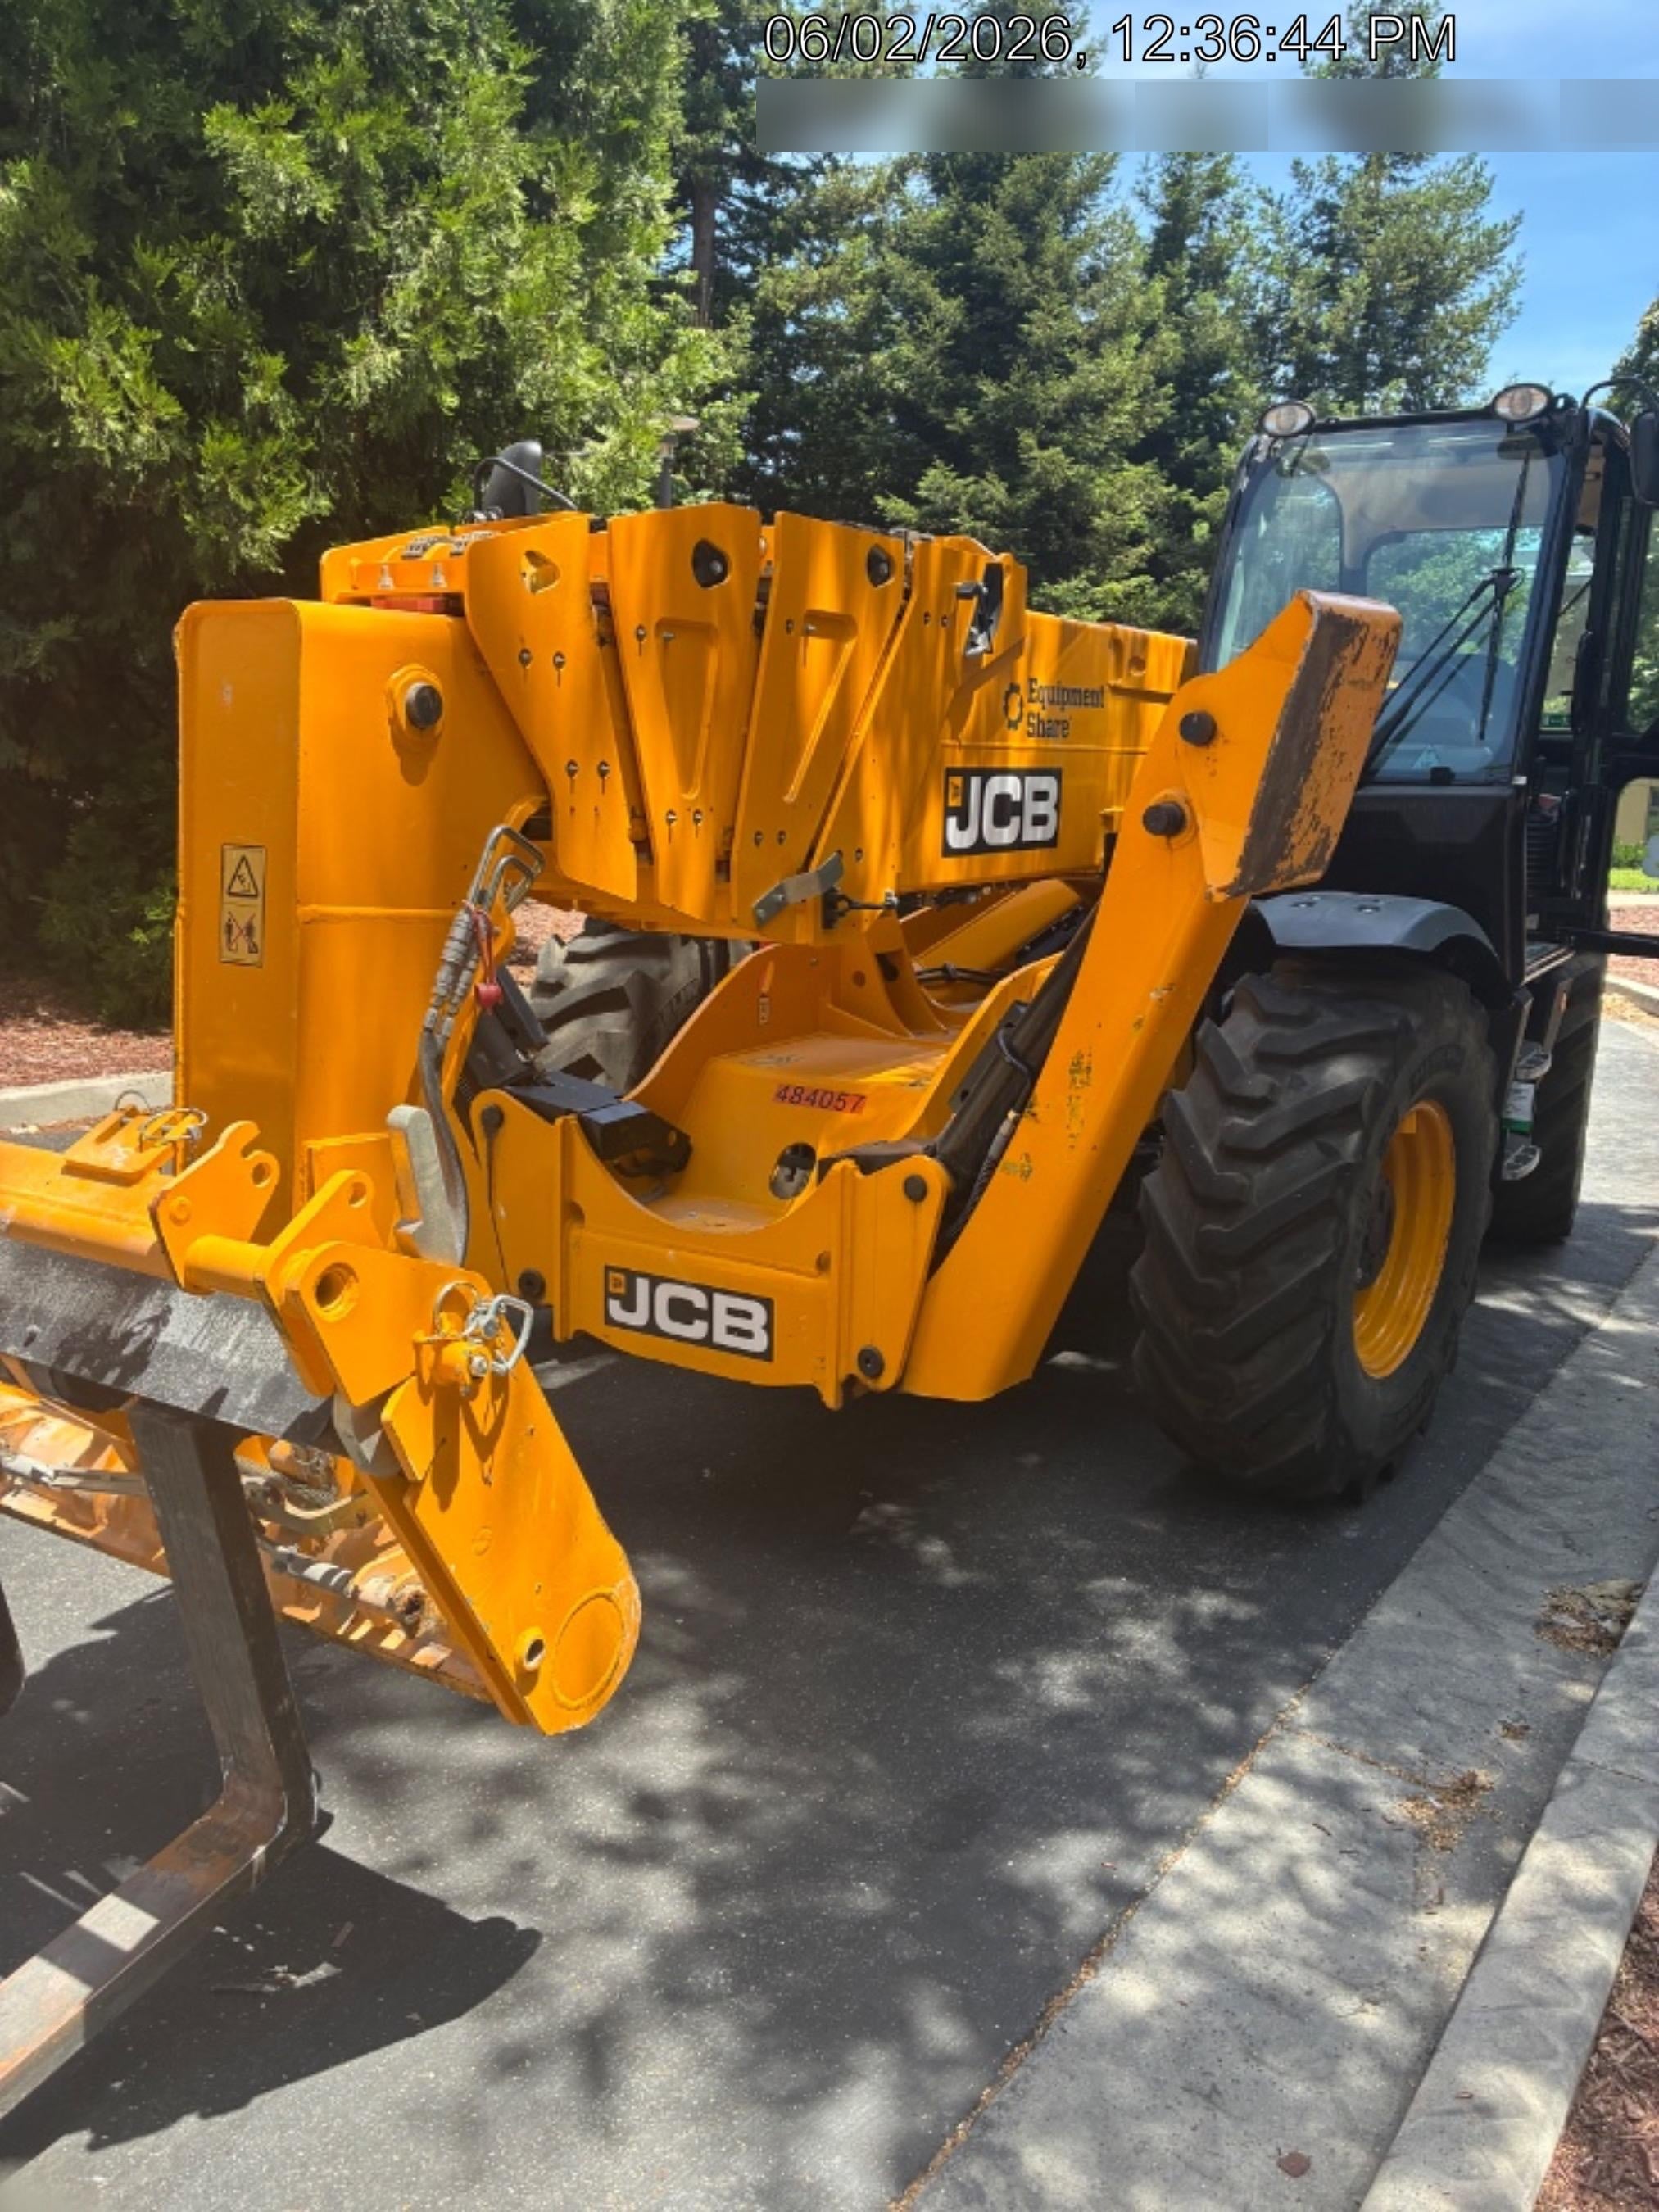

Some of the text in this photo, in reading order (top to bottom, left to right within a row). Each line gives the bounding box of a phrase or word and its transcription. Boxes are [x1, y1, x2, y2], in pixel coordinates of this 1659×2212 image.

[1027, 678, 1105, 711] Equipment
[1027, 714, 1070, 738] Share
[945, 775, 1059, 850] JCB
[776, 1085, 866, 1113] 484057
[608, 1276, 768, 1353] JCB
